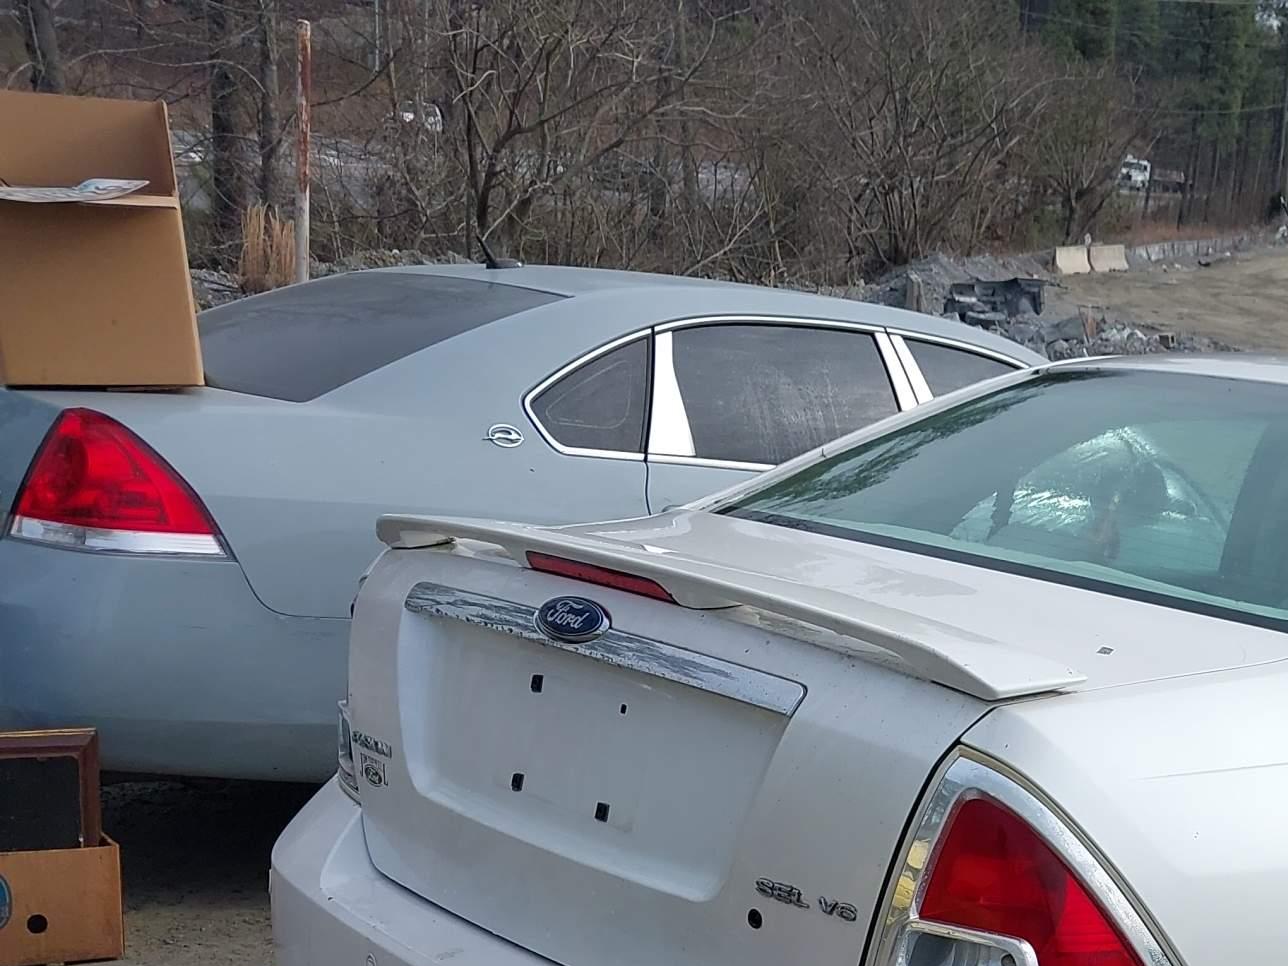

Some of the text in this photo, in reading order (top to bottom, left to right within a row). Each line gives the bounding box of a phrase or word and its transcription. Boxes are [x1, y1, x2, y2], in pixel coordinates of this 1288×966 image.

[547, 599, 591, 629] Ford
[756, 877, 857, 921] SEL V6
